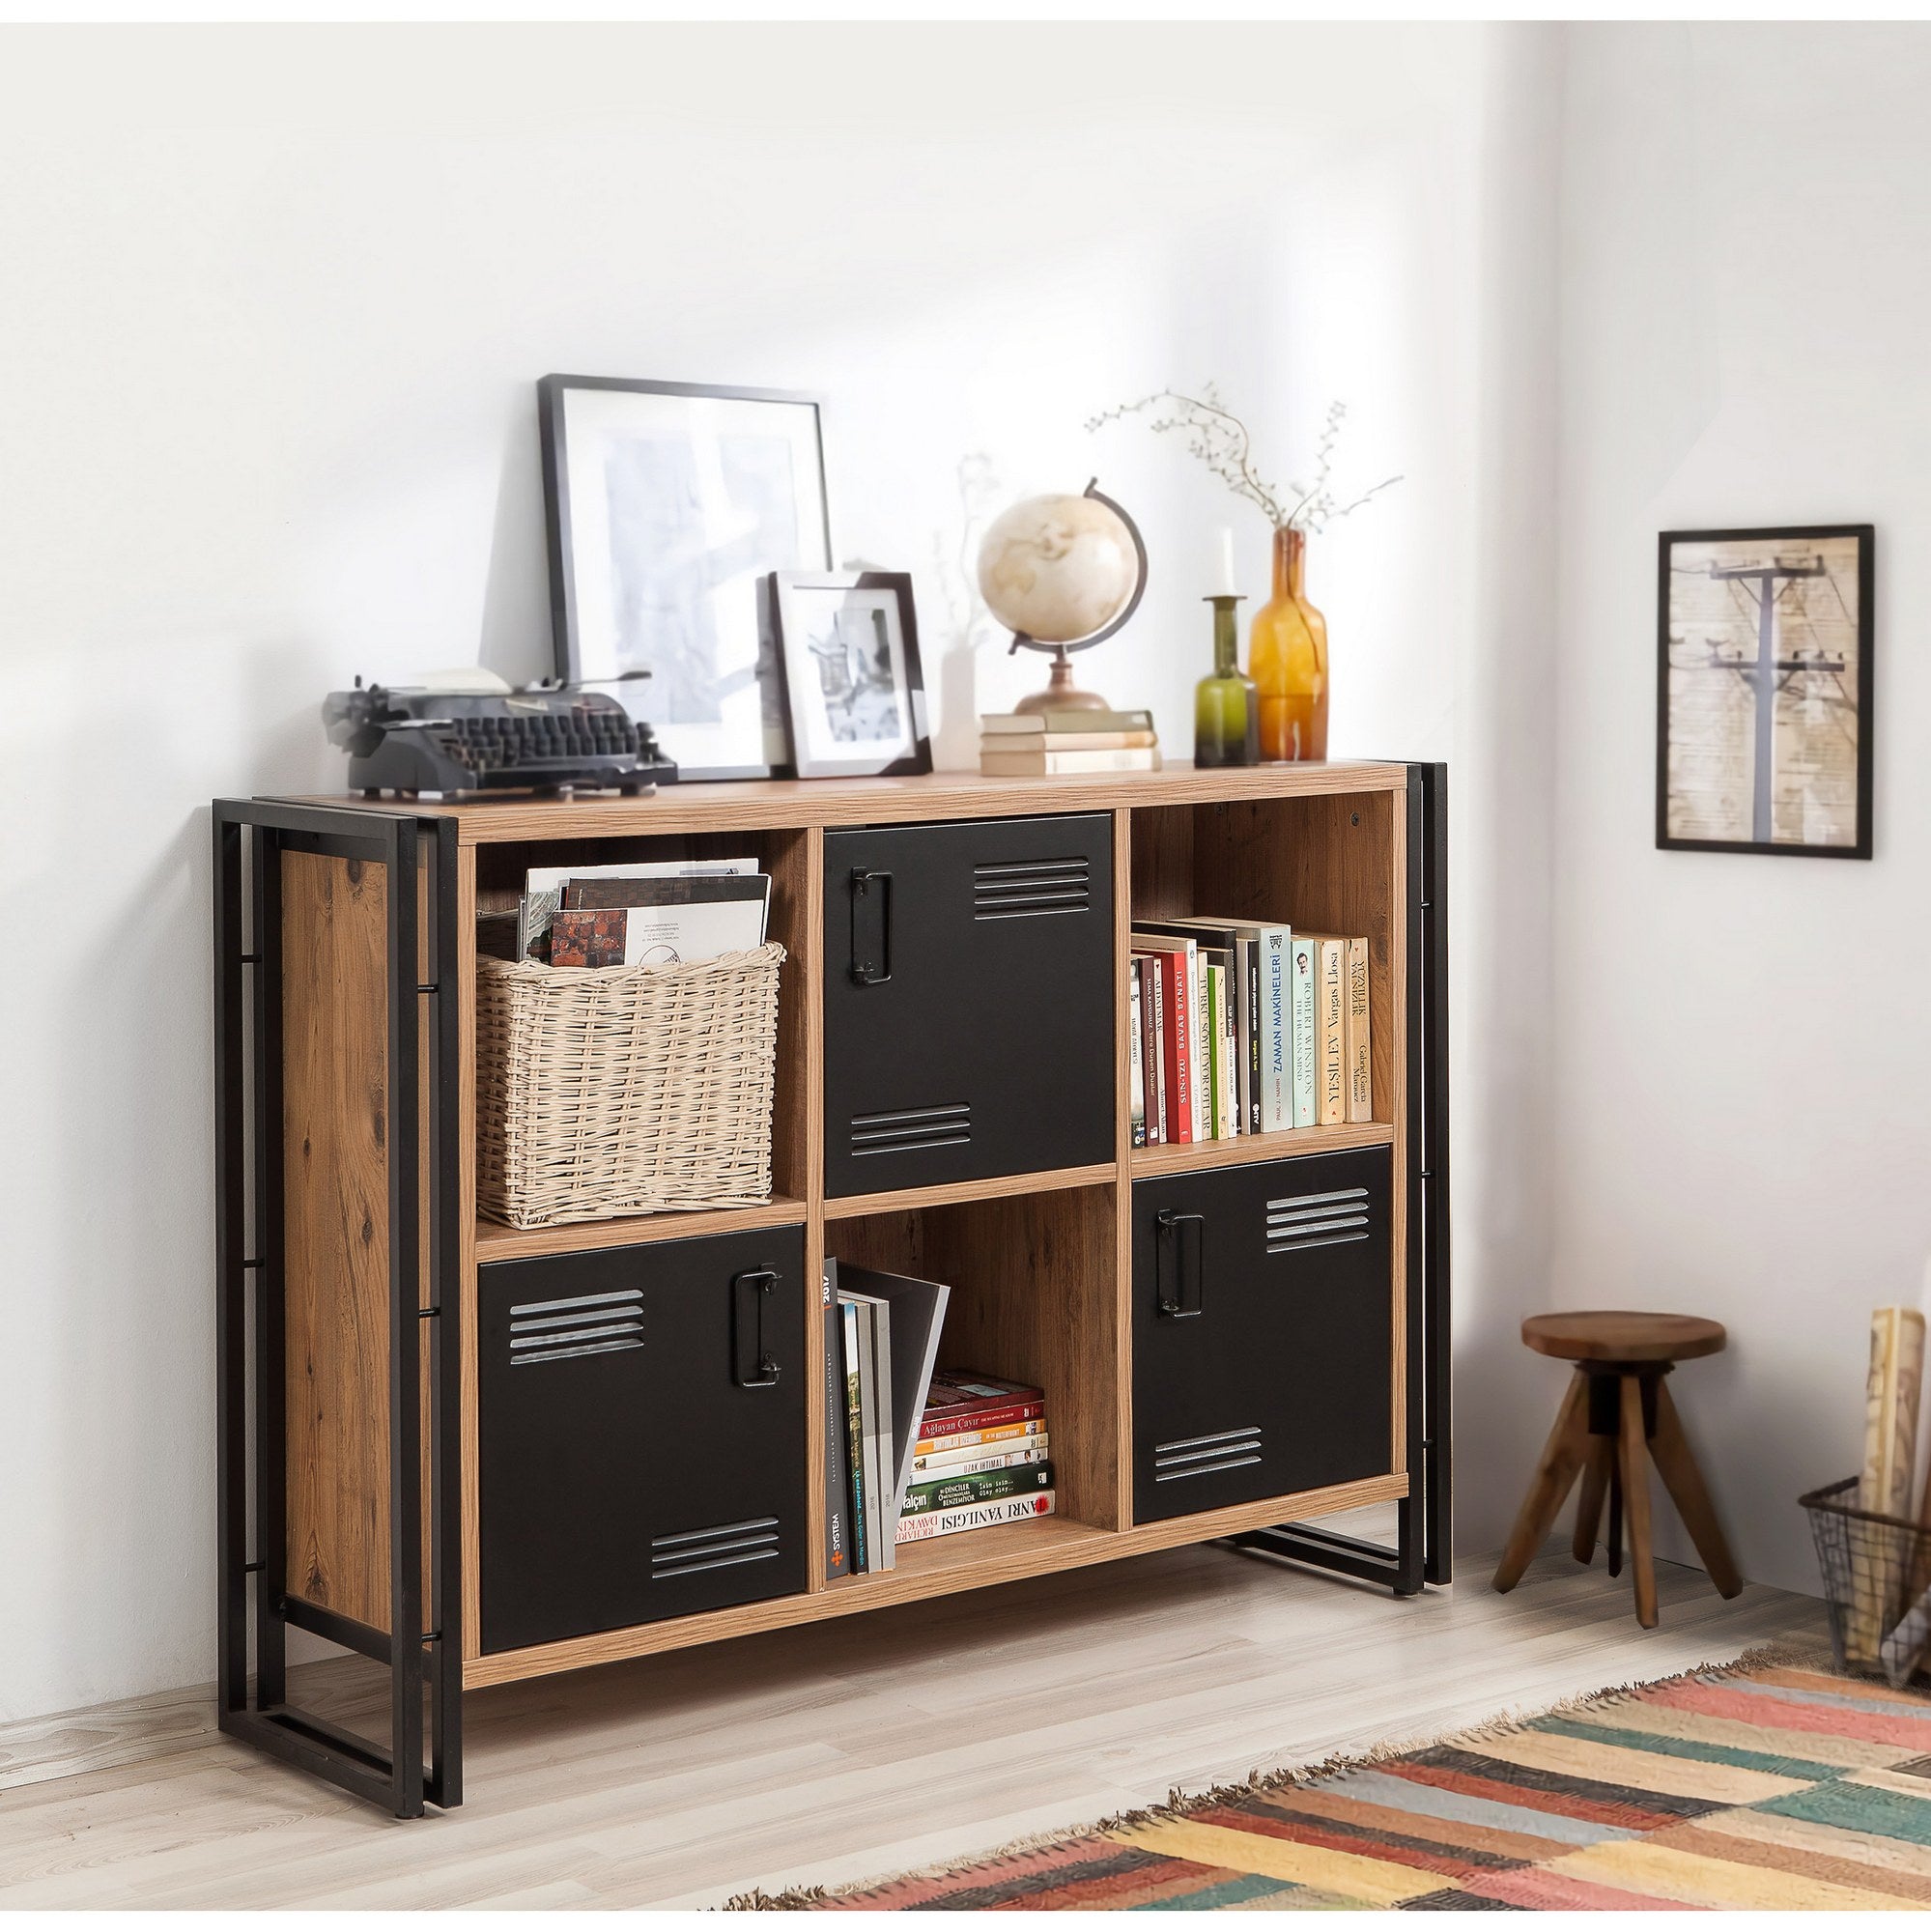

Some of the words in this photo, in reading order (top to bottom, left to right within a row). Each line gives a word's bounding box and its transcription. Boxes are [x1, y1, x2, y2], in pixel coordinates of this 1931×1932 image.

[1327, 952, 1339, 984] Llosa
[1269, 954, 1282, 1026] MAKİNELERİ
[1327, 989, 1341, 1028] Vargas
[1273, 1031, 1282, 1072] ZAMAN
[1327, 1034, 1339, 1055] EV
[1358, 1045, 1367, 1074] Gabriel
[923, 1422, 955, 1436] Ağlayan
[958, 1418, 980, 1430] Çayır
[964, 1463, 979, 1474] UZAK
[897, 1515, 937, 1531] DAWKIN
[942, 1507, 1003, 1530] YANILGISI
[832, 1514, 840, 1550] SYSTEM
[895, 1528, 933, 1542] RICHARD
